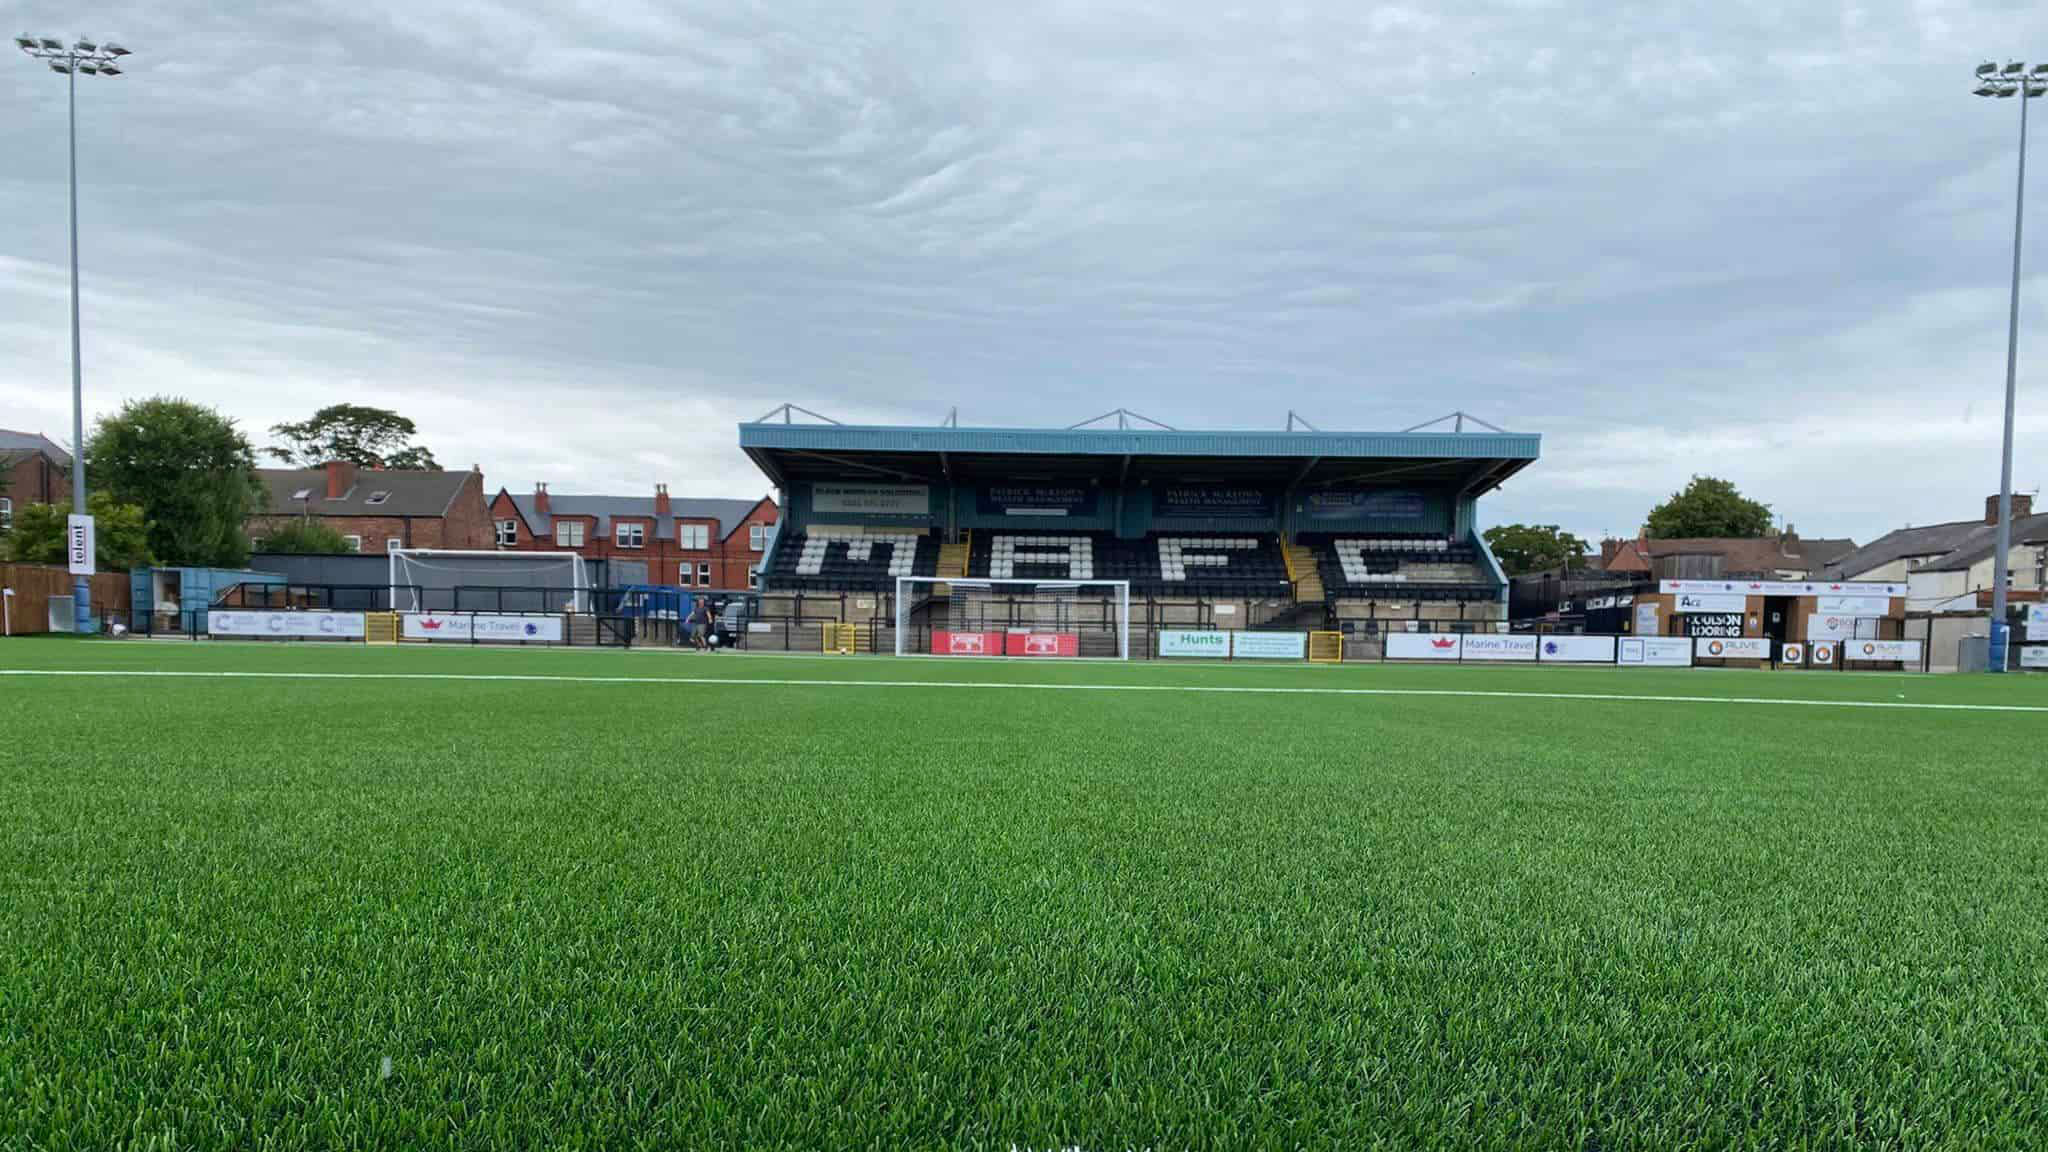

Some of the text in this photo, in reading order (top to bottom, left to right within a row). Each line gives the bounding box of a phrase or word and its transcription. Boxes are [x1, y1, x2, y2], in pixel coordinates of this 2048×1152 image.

[71, 525, 83, 564] tolent
[449, 621, 487, 631] Marne
[1180, 633, 1224, 645] Hunts
[1465, 639, 1534, 649] Marine Travel
